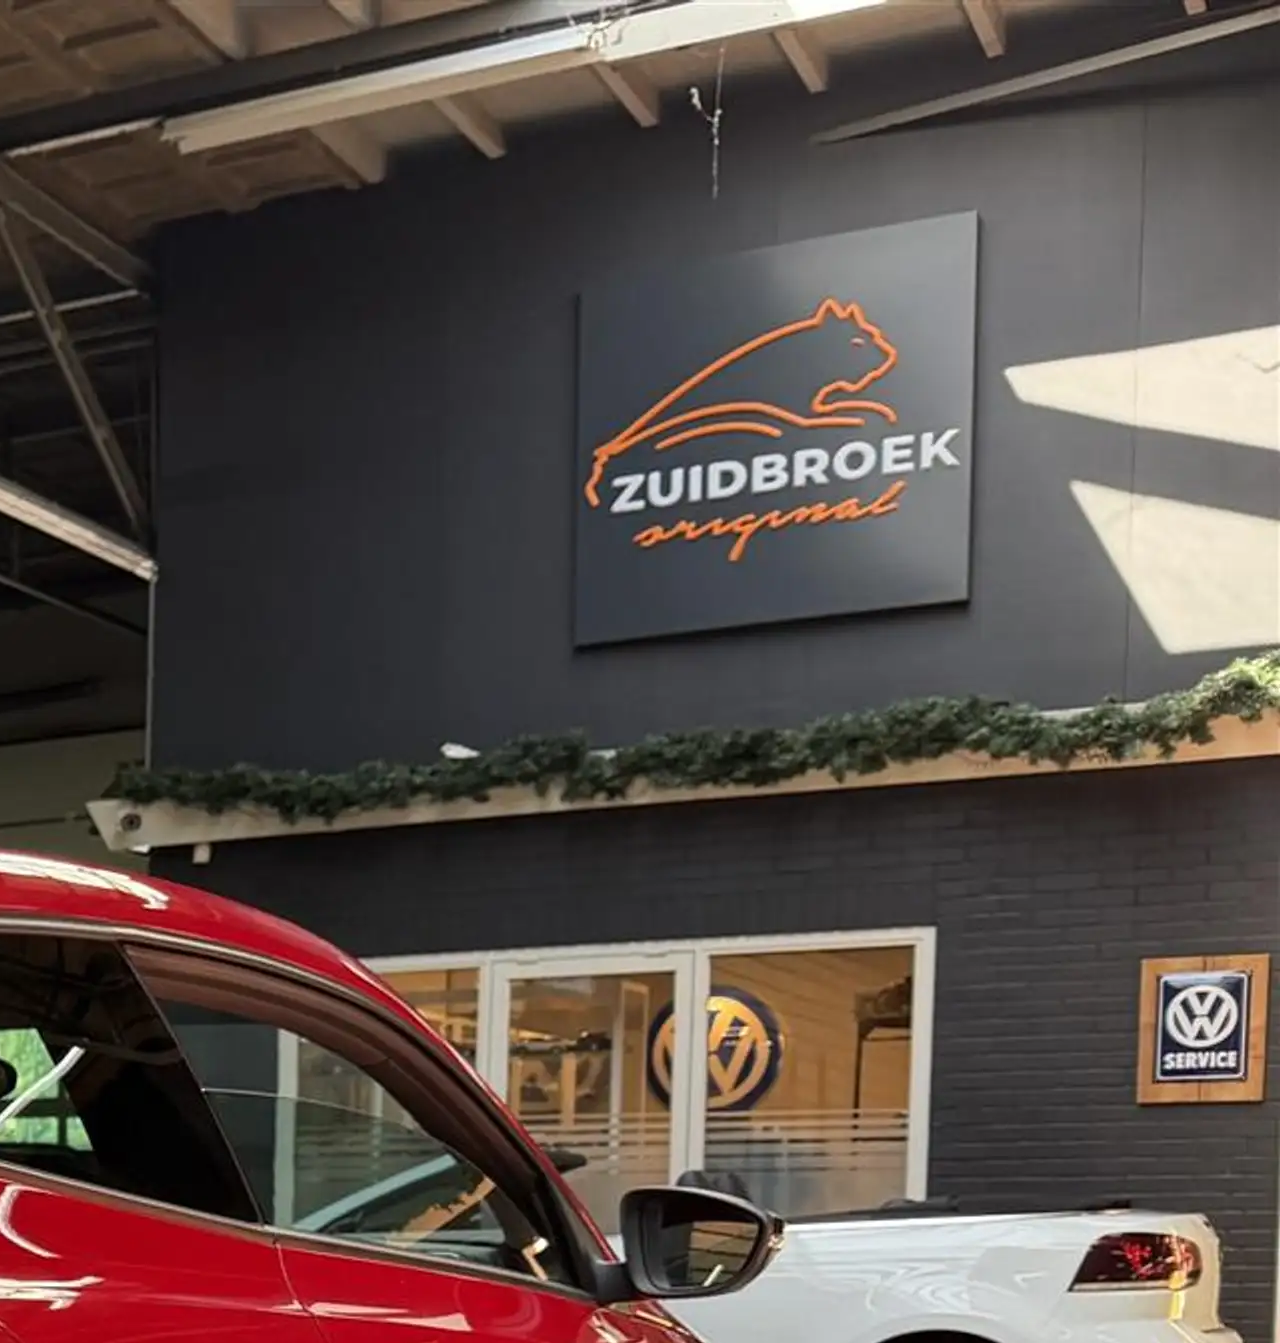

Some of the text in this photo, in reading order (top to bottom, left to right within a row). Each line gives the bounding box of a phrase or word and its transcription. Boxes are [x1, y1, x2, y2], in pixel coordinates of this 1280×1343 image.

[610, 428, 961, 513] ZUIDBROEK
[632, 480, 907, 561] original
[1163, 1051, 1238, 1069] SERVICE
